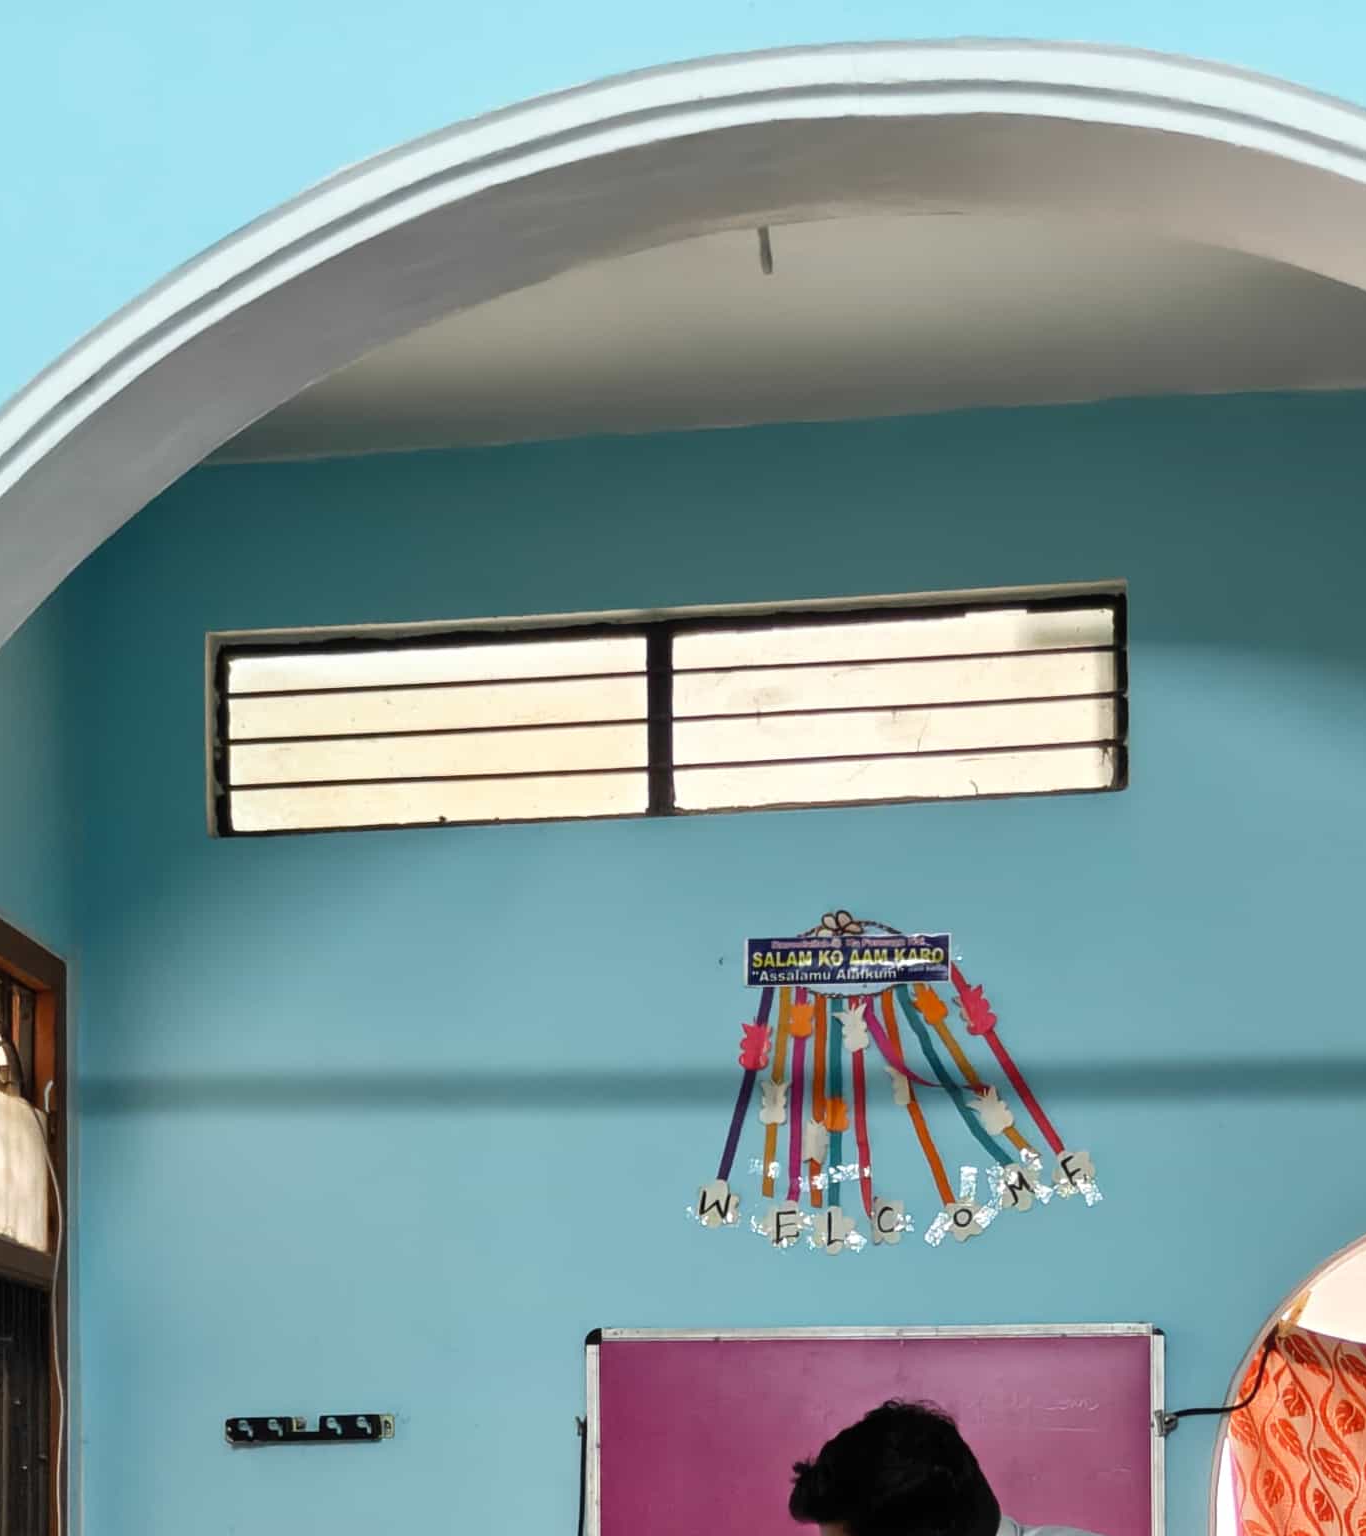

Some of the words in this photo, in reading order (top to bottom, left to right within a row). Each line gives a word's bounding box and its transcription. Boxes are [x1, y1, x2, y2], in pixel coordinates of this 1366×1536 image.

[753, 950, 812, 967] SALAM
[819, 949, 844, 966] KO
[850, 948, 887, 965] AAM
[894, 947, 945, 964] KARO
